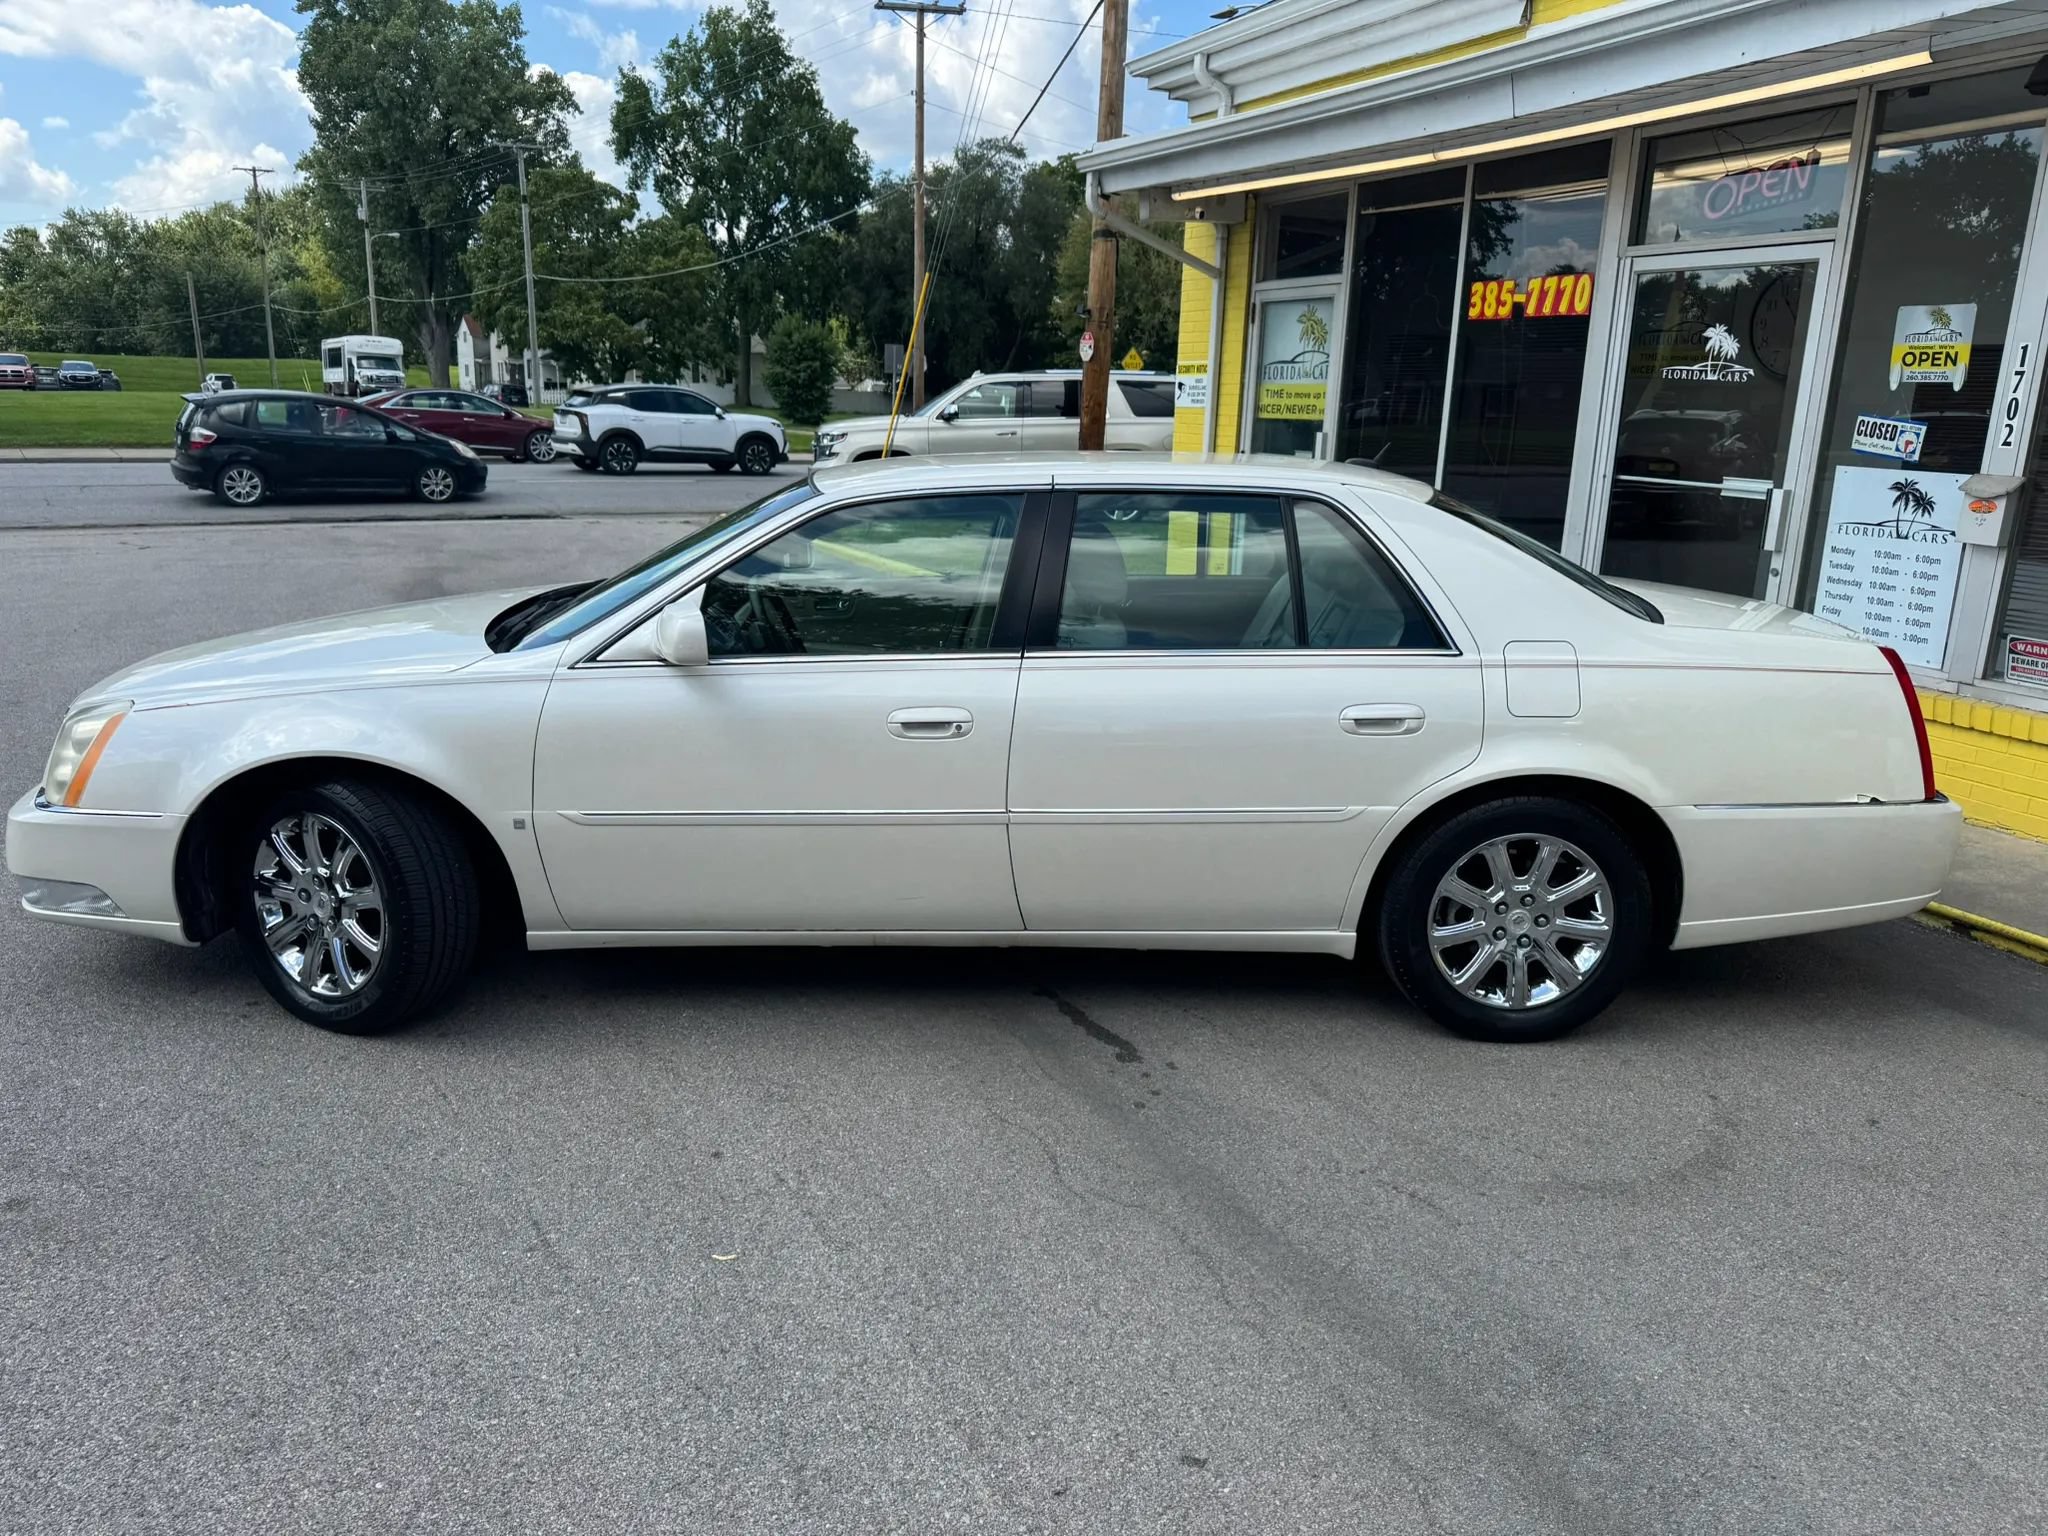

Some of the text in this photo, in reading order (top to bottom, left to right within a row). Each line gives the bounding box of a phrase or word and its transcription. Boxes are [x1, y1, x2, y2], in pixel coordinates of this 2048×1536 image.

[1703, 156, 1813, 219] OPEN
[1905, 334, 1958, 343] FLORIDA CARS
[1902, 351, 1959, 367] OPEN
[1264, 365, 1329, 380] FLORIDA CA
[1662, 369, 1749, 382] FLORIDA CARS
[1266, 389, 1284, 399] TIME
[1286, 391, 1293, 399] to
[1313, 392, 1322, 401] up
[2001, 344, 2029, 447] 1702
[1258, 403, 1318, 415] NICER/NEWER
[1856, 419, 1899, 442] CLOSED
[1838, 525, 1949, 545] FLORIDA CARS
[1831, 545, 1856, 557] Monday
[1874, 550, 1902, 560] 10:00am
[1915, 554, 1941, 566] 6:00pm
[1829, 560, 1855, 572] Tuesday
[1871, 565, 1899, 576] 10:00am
[1913, 570, 1939, 582] 6:00pm
[1826, 576, 1862, 589] Wednesday
[1869, 581, 1896, 592] 10:00am
[1910, 586, 1936, 598] 6:00pm
[1824, 590, 1854, 603] Thursday
[1867, 596, 1894, 607] 10:00am
[1907, 602, 1934, 613] 6:00pm
[1822, 605, 1842, 617] Friday
[1864, 612, 1892, 622] 10:00am
[1905, 617, 1931, 629] 6:00pm
[1862, 627, 1889, 638] 10:00am
[1902, 633, 1928, 645] 3:00pm
[2016, 642, 2048, 656] WARN
[2011, 656, 2040, 668] BEWARE
